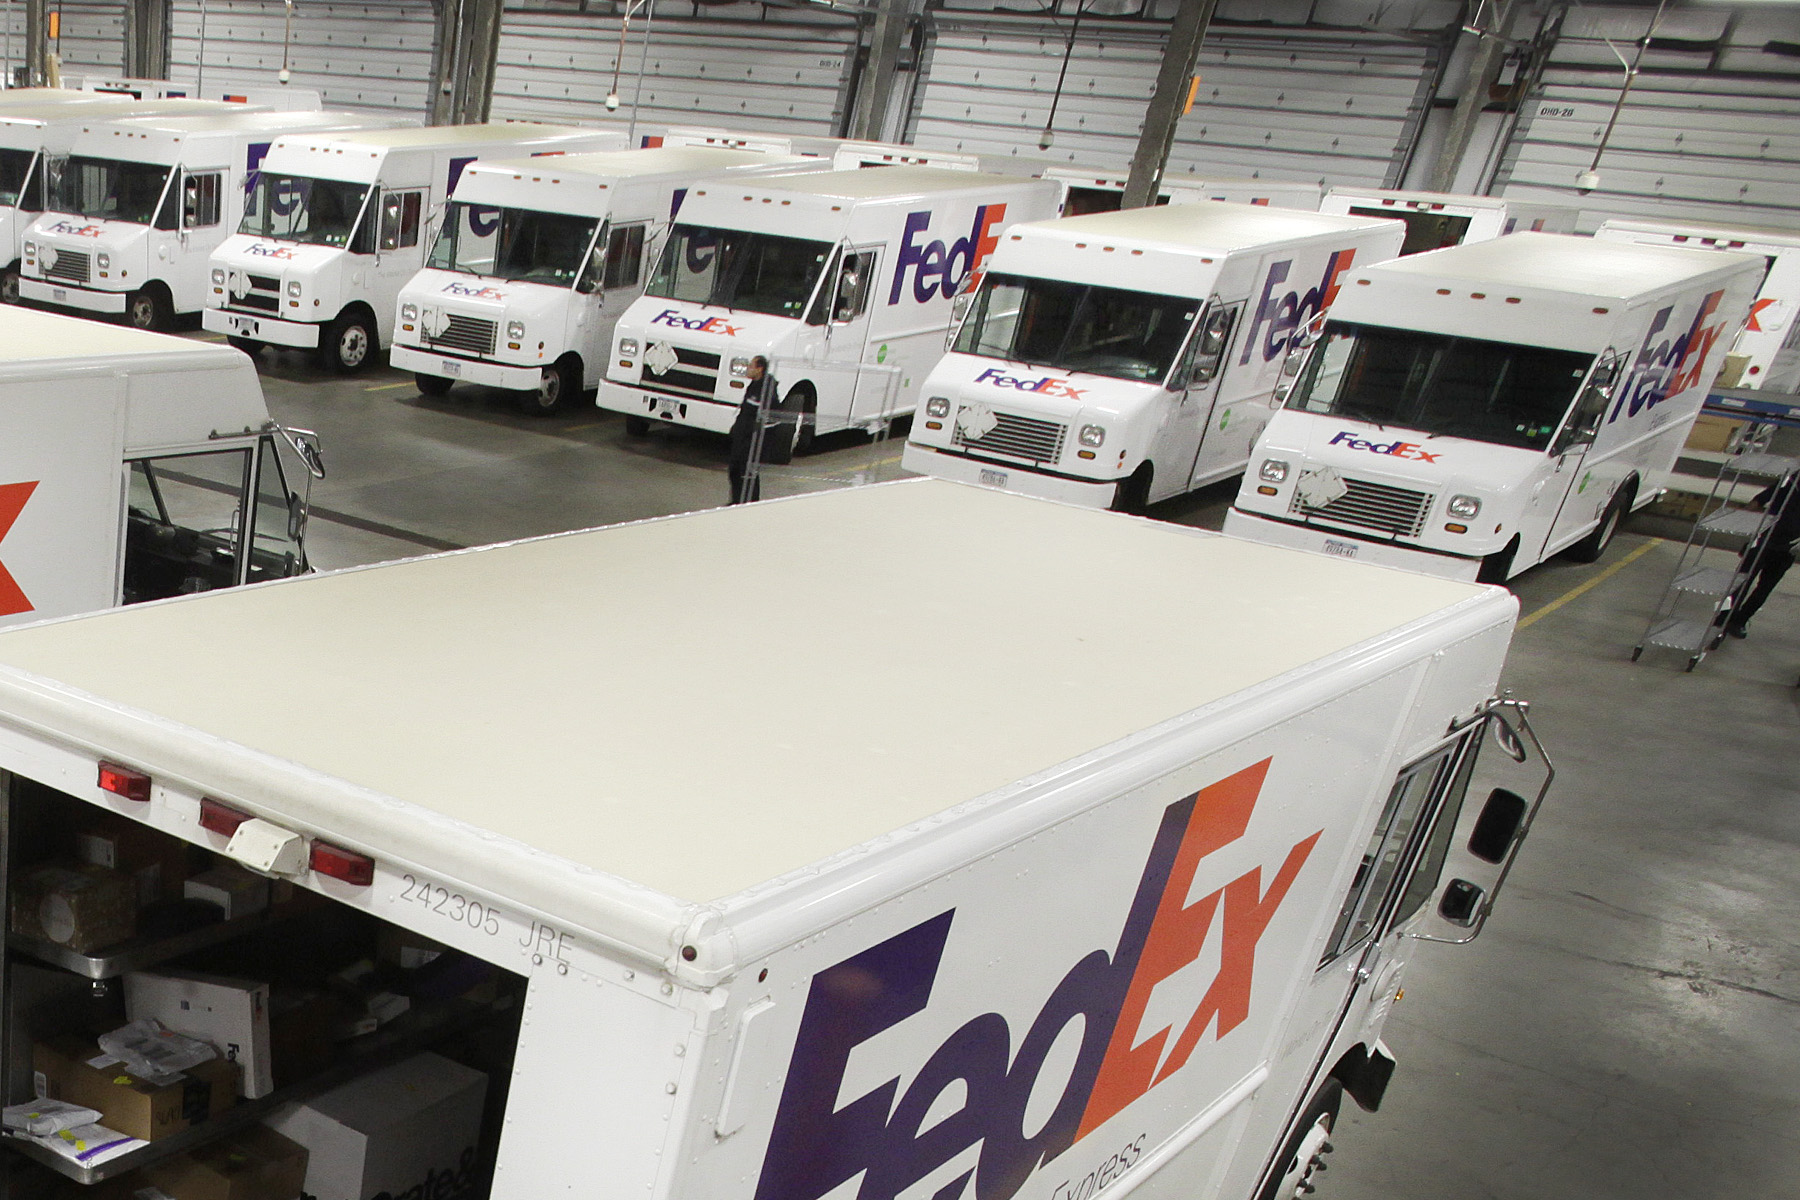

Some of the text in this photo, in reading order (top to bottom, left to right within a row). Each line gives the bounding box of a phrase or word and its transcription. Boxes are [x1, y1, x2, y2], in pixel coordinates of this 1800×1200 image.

[47, 220, 108, 239] FedEx
[242, 242, 300, 260] FedEx
[887, 203, 1008, 307] FedE
[440, 281, 509, 301] FedEx
[649, 308, 747, 338] FedEx
[1607, 288, 1728, 425] FedEx
[973, 367, 1091, 401] FedEx
[1327, 431, 1444, 464] FedEx
[400, 873, 576, 965] 242305 JRE
